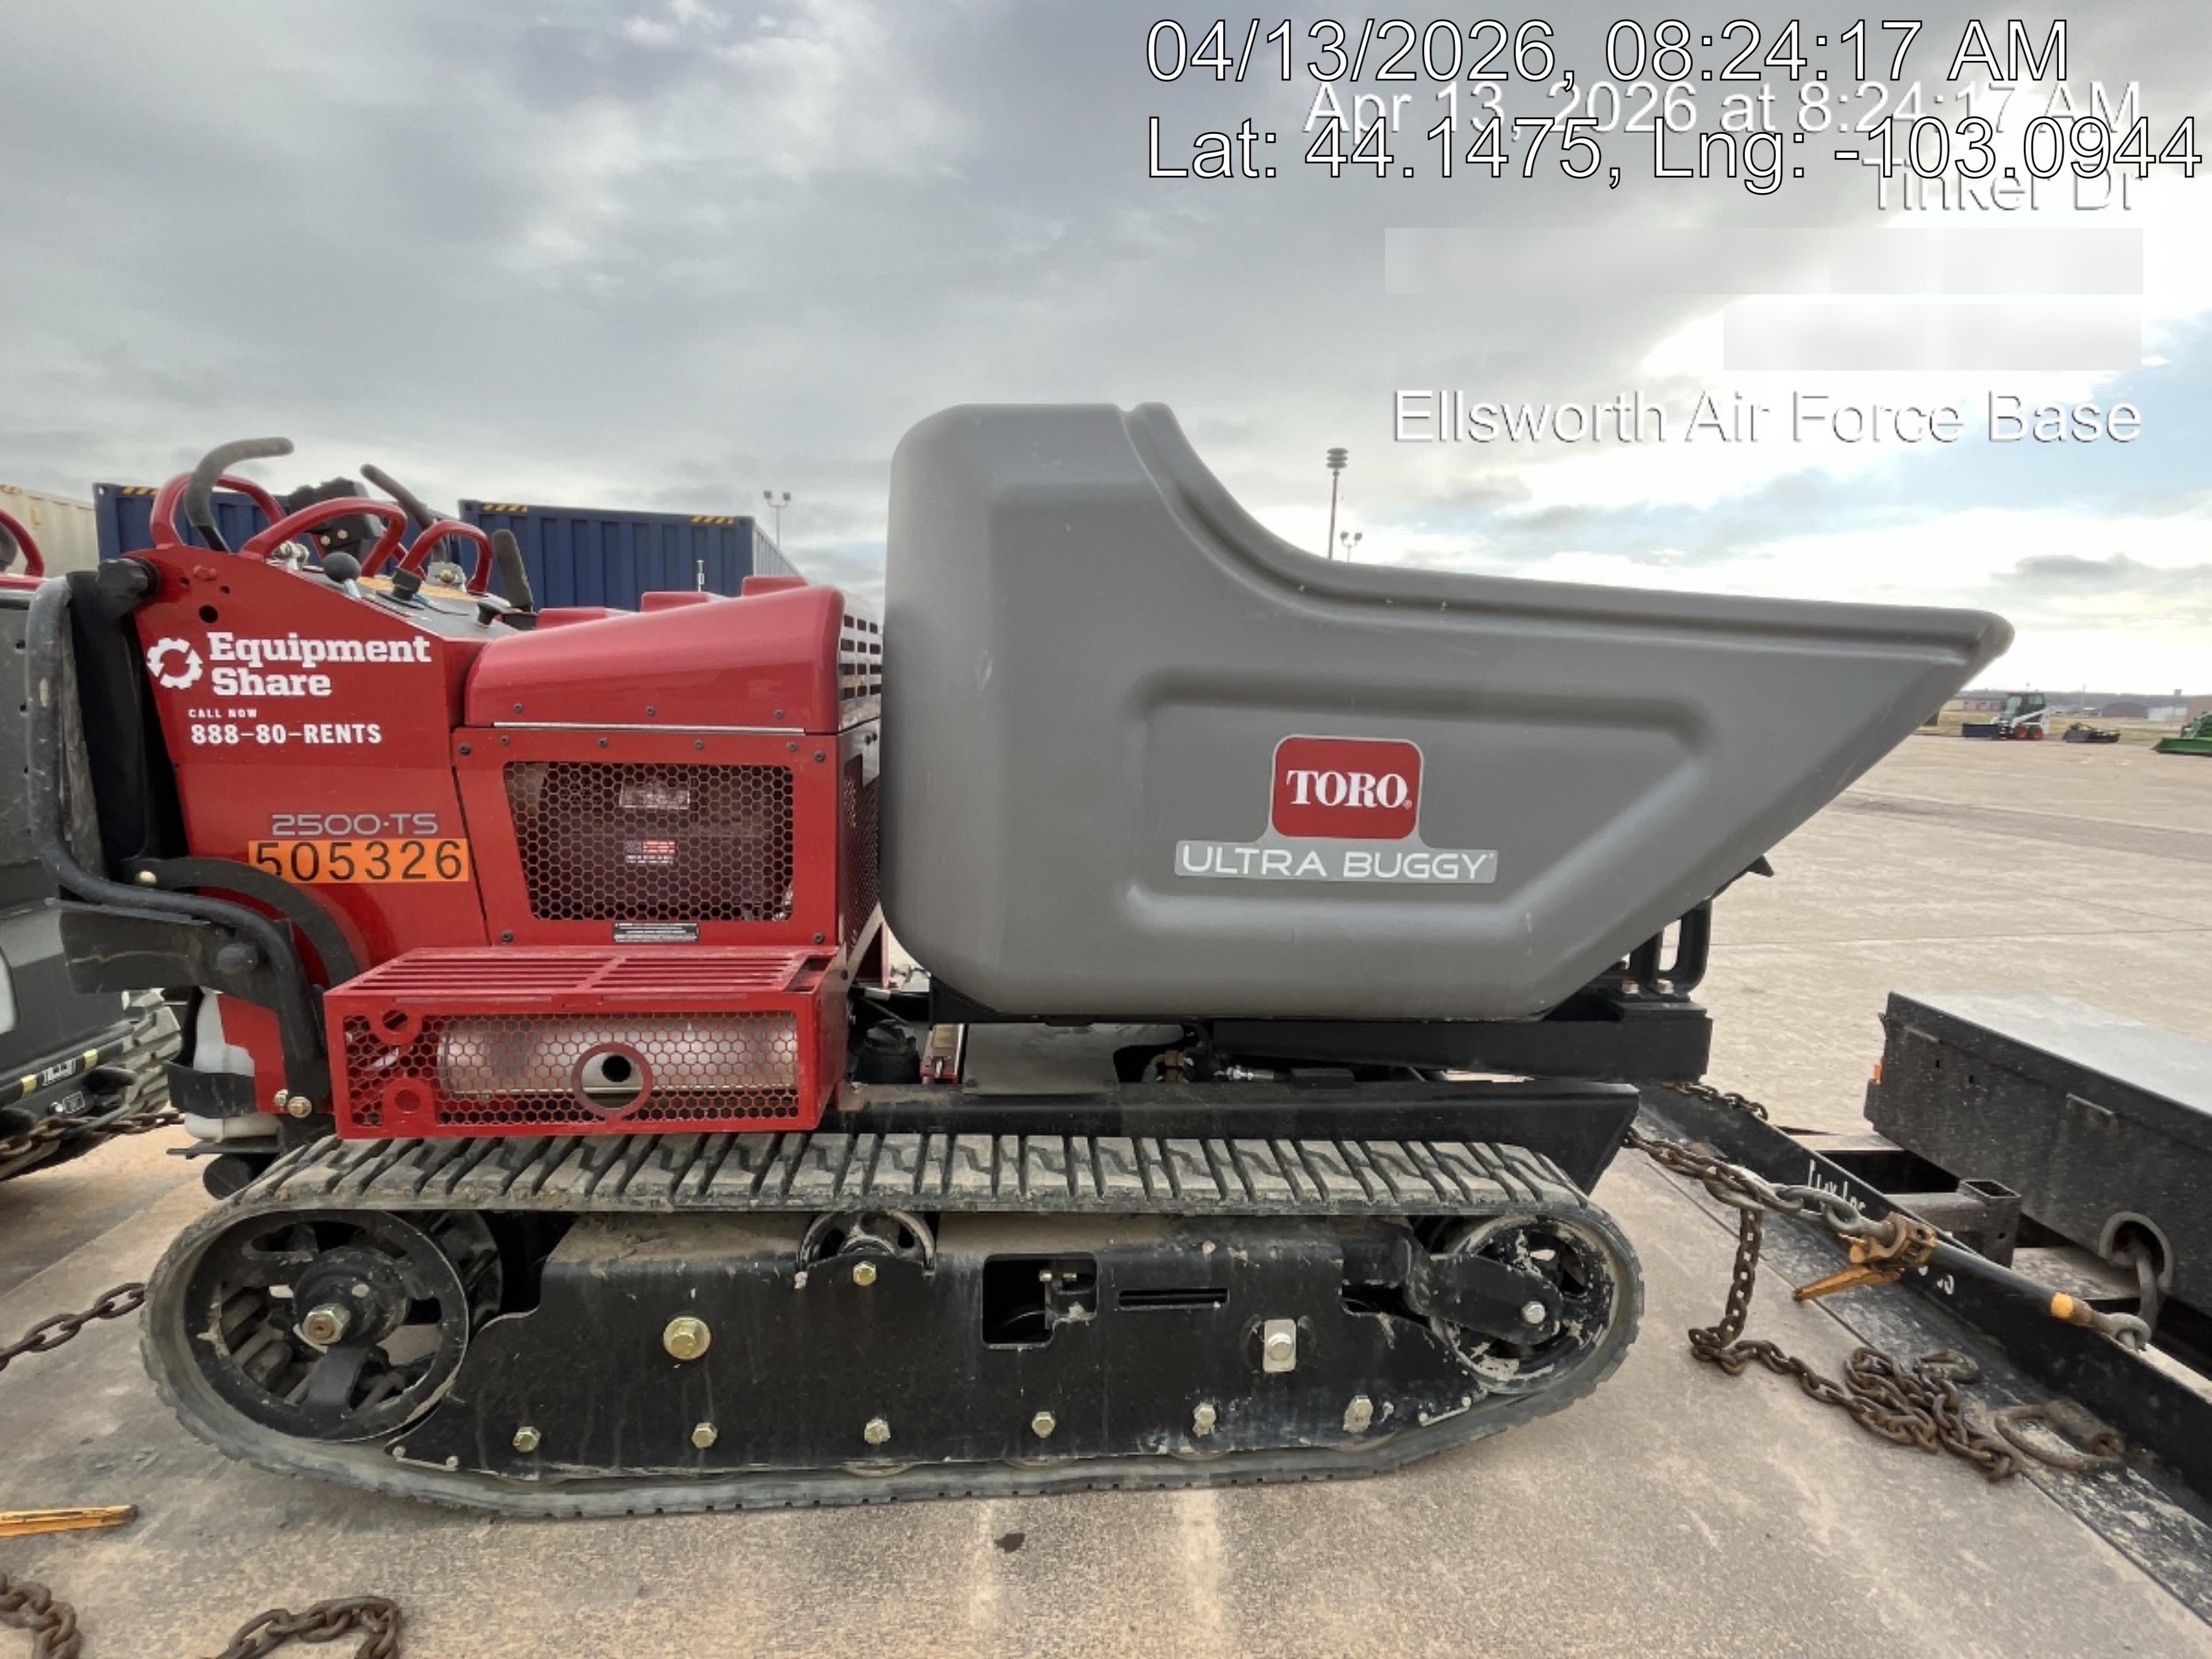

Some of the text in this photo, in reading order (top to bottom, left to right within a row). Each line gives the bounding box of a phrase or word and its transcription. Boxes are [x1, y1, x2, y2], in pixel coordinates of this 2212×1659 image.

[207, 631, 432, 668] Equipment
[211, 666, 332, 697] Share
[188, 708, 257, 718] CALL NOW
[190, 723, 382, 745] 888-80-RENTS
[256, 840, 462, 882] 505326
[1182, 845, 1488, 880] ULTRA BUGGY
